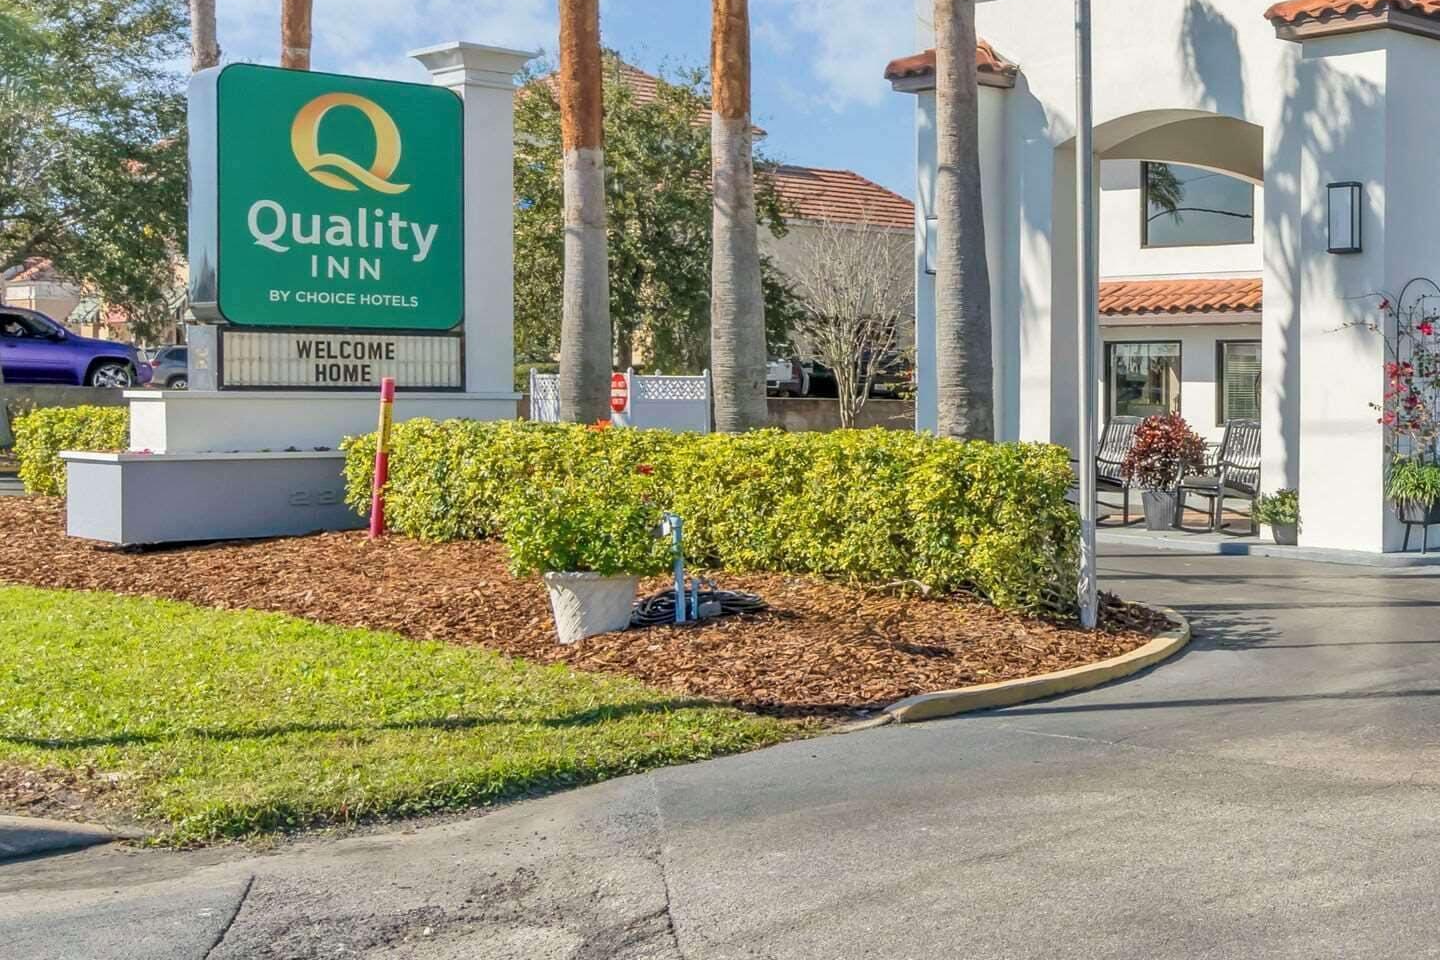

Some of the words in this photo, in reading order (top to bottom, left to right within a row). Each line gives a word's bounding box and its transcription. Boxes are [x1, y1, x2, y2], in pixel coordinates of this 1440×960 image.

[291, 92, 411, 194] Q
[247, 199, 439, 262] Quality
[311, 254, 381, 281] INN
[269, 290, 291, 303] BY
[295, 291, 356, 306] CHOICE
[360, 294, 419, 309] HOTELS
[296, 340, 396, 361] WELCOME
[315, 363, 372, 383] HOME
